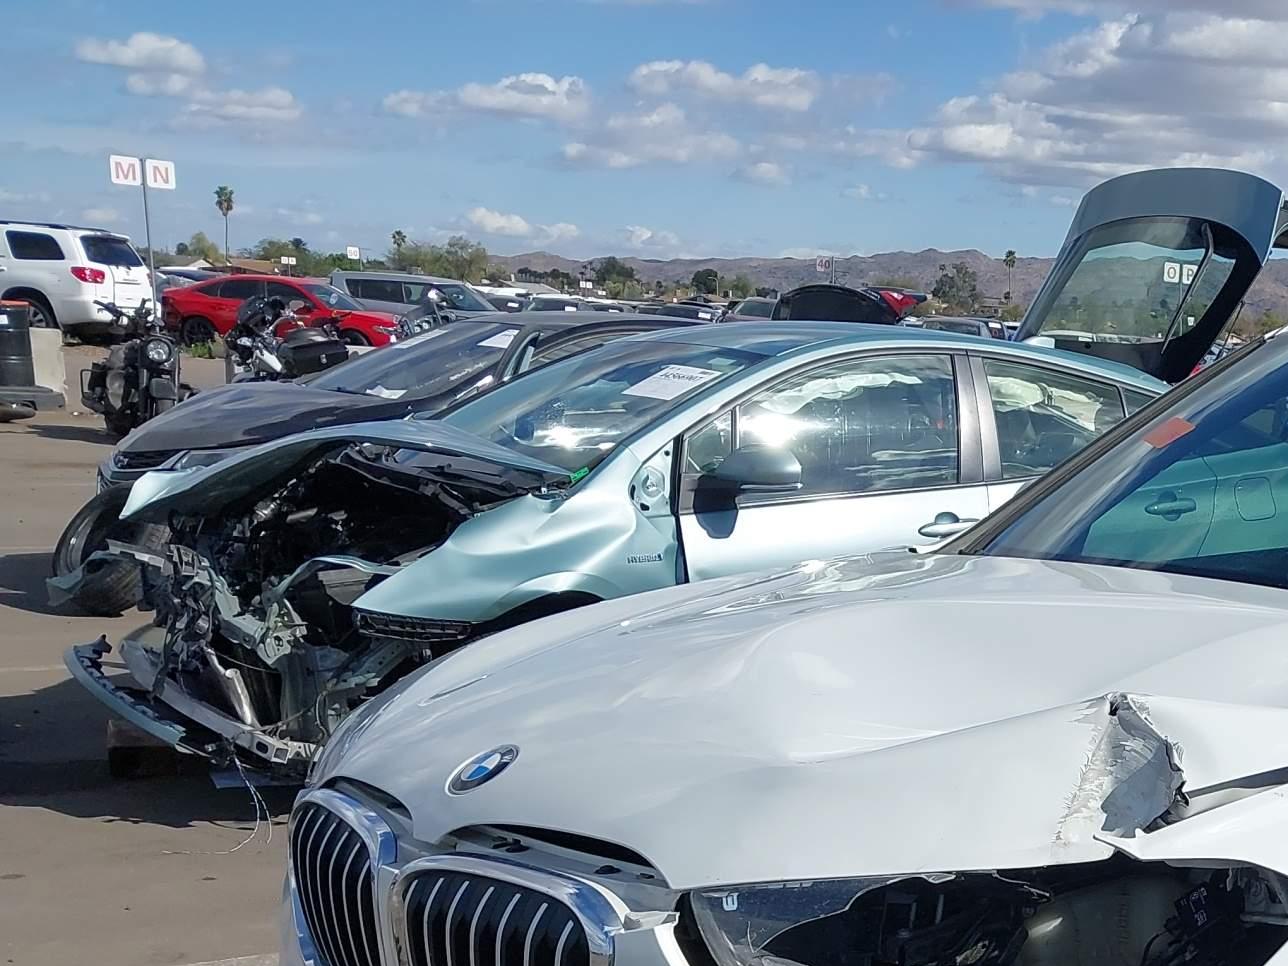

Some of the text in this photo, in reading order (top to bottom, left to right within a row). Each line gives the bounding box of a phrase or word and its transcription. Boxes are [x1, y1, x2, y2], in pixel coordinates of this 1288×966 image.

[115, 161, 137, 181] M
[152, 165, 169, 184] N
[818, 258, 831, 269] 40
[1187, 268, 1195, 281] P
